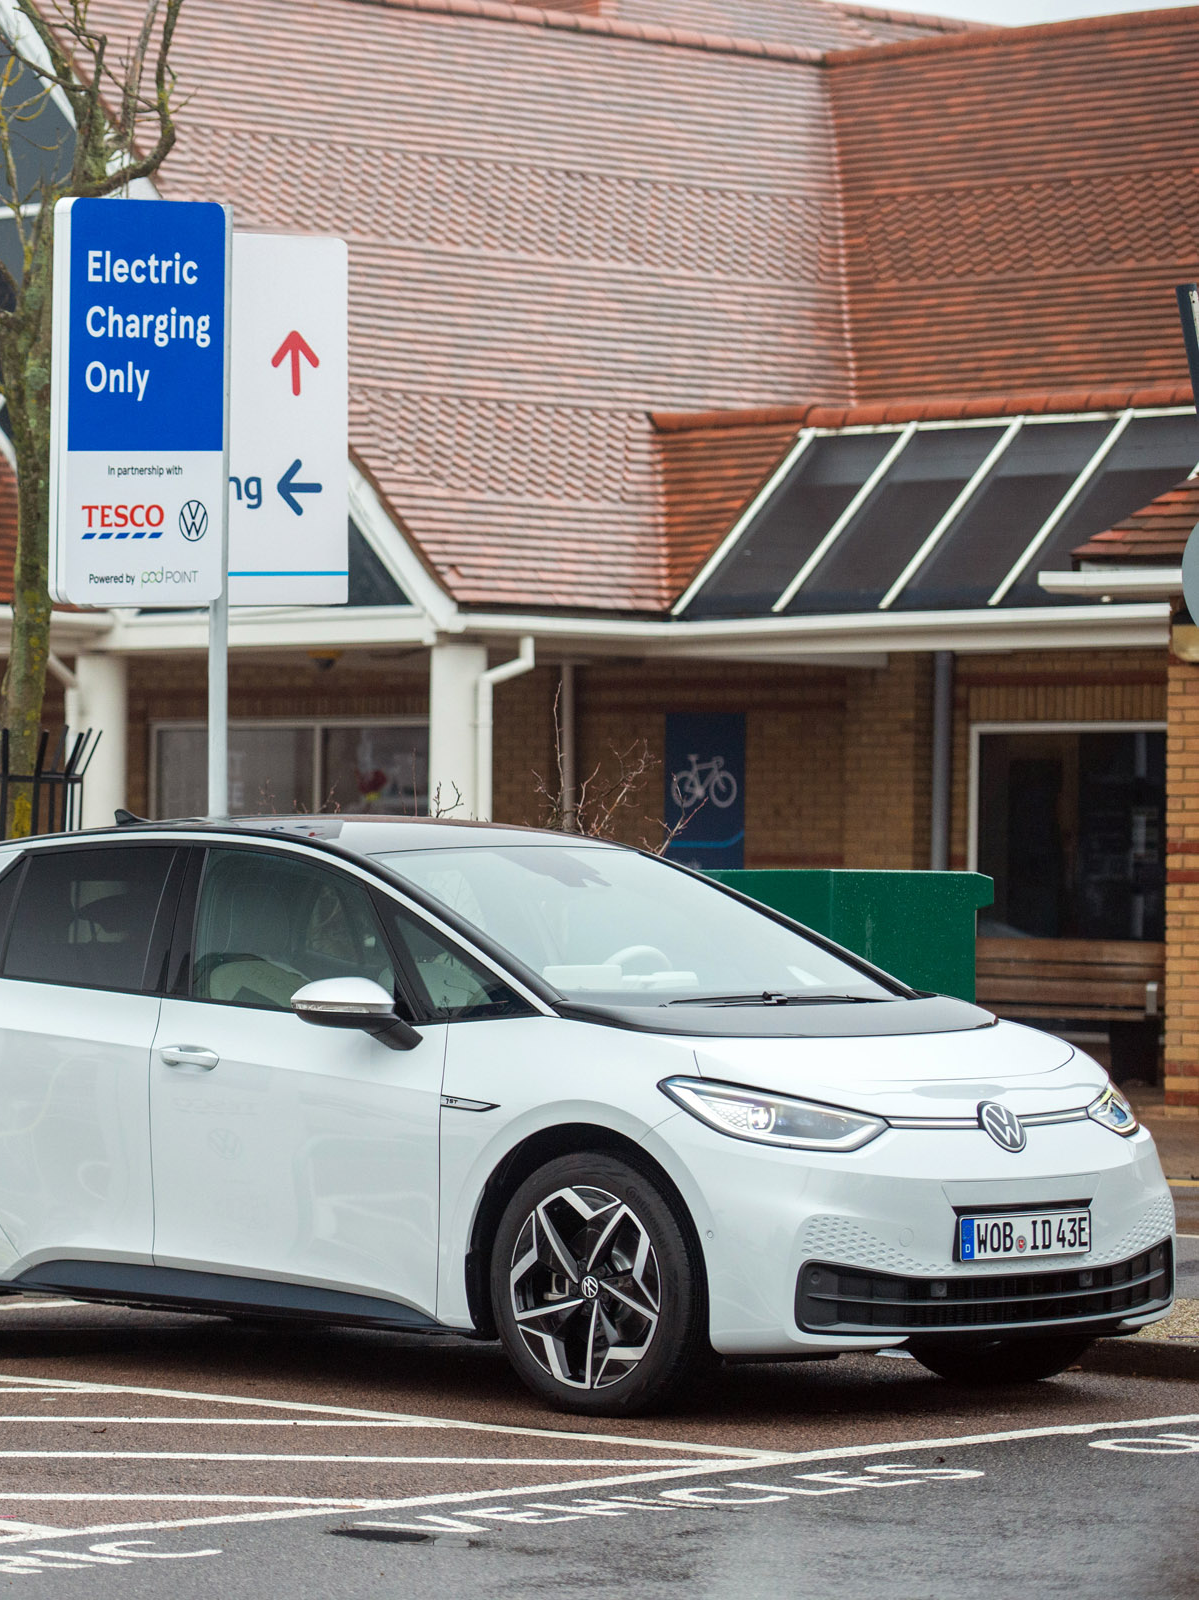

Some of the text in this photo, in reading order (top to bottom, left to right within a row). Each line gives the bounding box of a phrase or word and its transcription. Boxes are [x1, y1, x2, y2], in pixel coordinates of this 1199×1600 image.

[87, 250, 199, 285] Electric
[85, 305, 212, 348] Charging
[84, 361, 150, 401] Only
[107, 465, 183, 478] In partnership with
[228, 475, 263, 509] ng
[81, 504, 164, 527] TESCO
[89, 566, 199, 589] Powered by pod POINT
[975, 1221, 1014, 1253] WOB
[1056, 1216, 1089, 1249] 43E
[354, 1463, 986, 1534] VEHICLES
